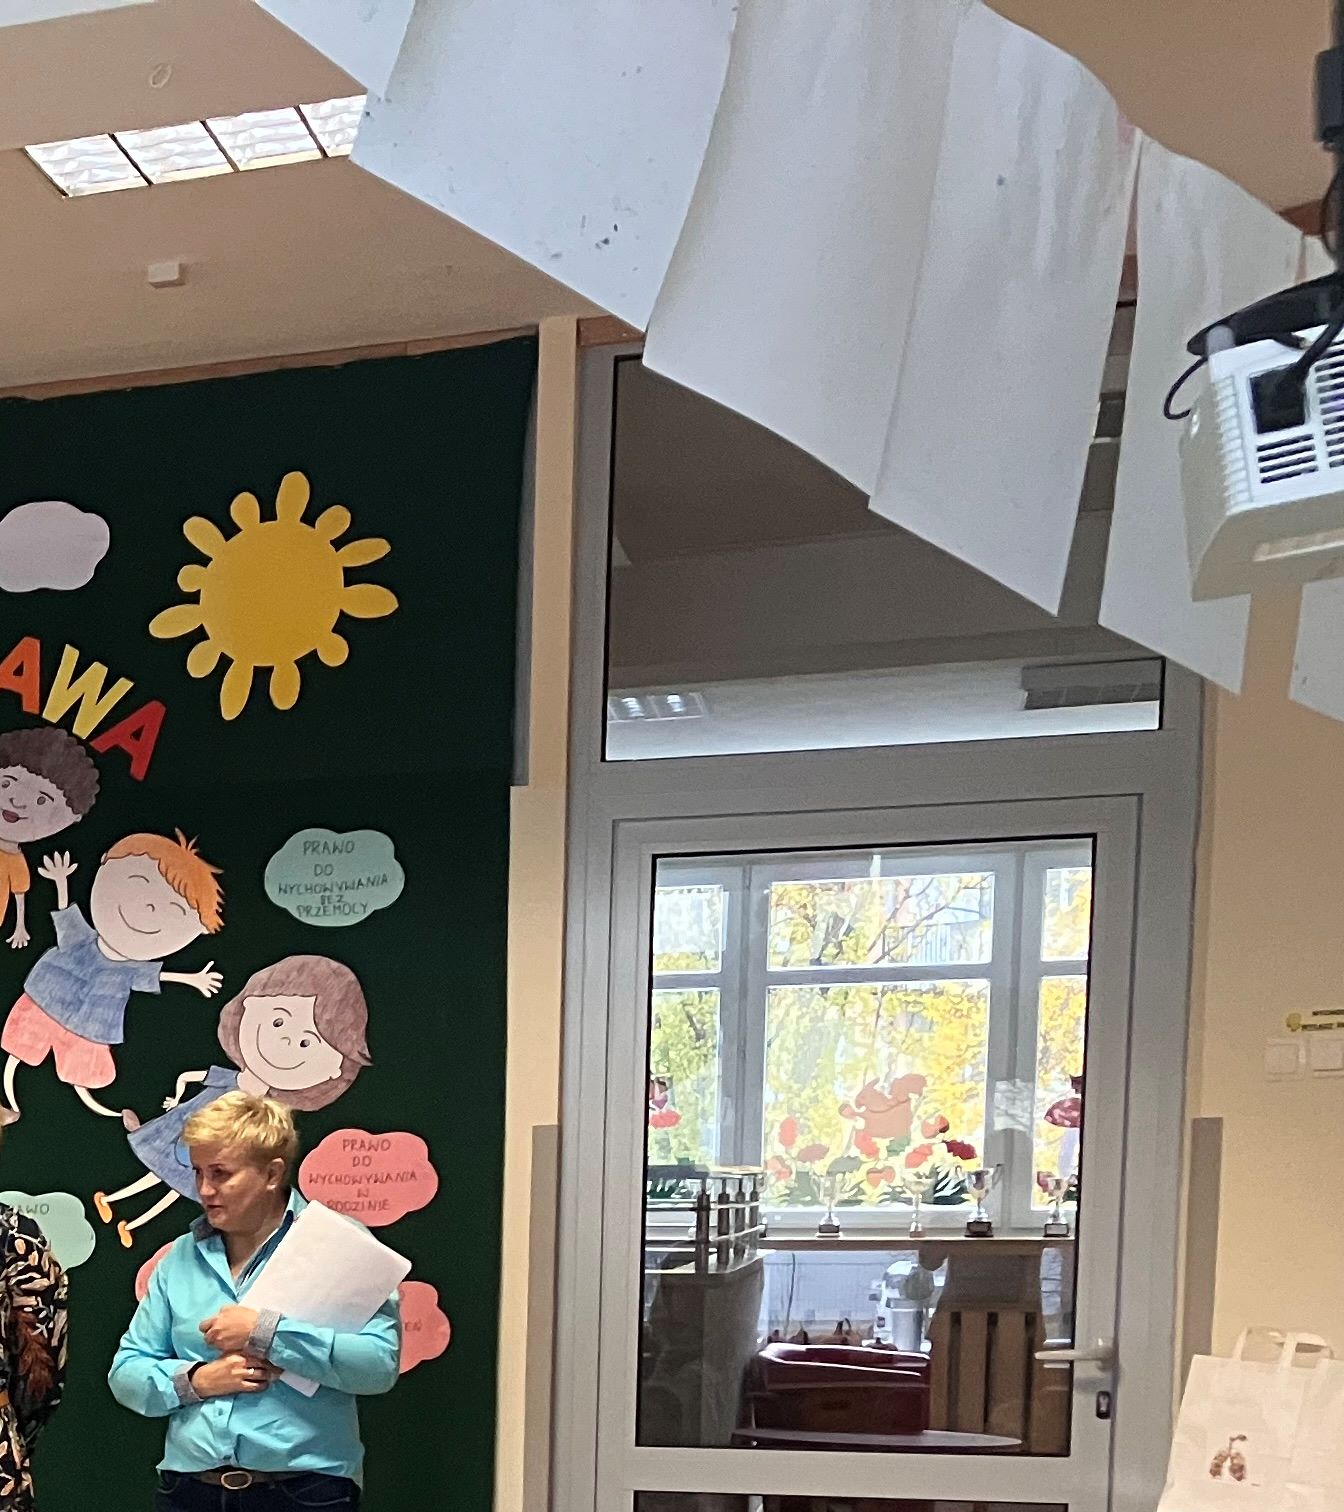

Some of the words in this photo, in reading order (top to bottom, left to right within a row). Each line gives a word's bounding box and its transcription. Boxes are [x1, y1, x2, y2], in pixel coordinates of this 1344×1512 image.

[303, 840, 355, 856] PRAWO
[313, 863, 334, 877] DO
[320, 895, 344, 905] BEZ
[296, 902, 369, 918] PRZEMOCY
[342, 1138, 391, 1152] PRAWO
[352, 1155, 372, 1168] DO
[309, 1171, 418, 1185] WYCHOWYWANIA
[357, 1188, 369, 1198] W
[17, 1203, 50, 1215] AWO
